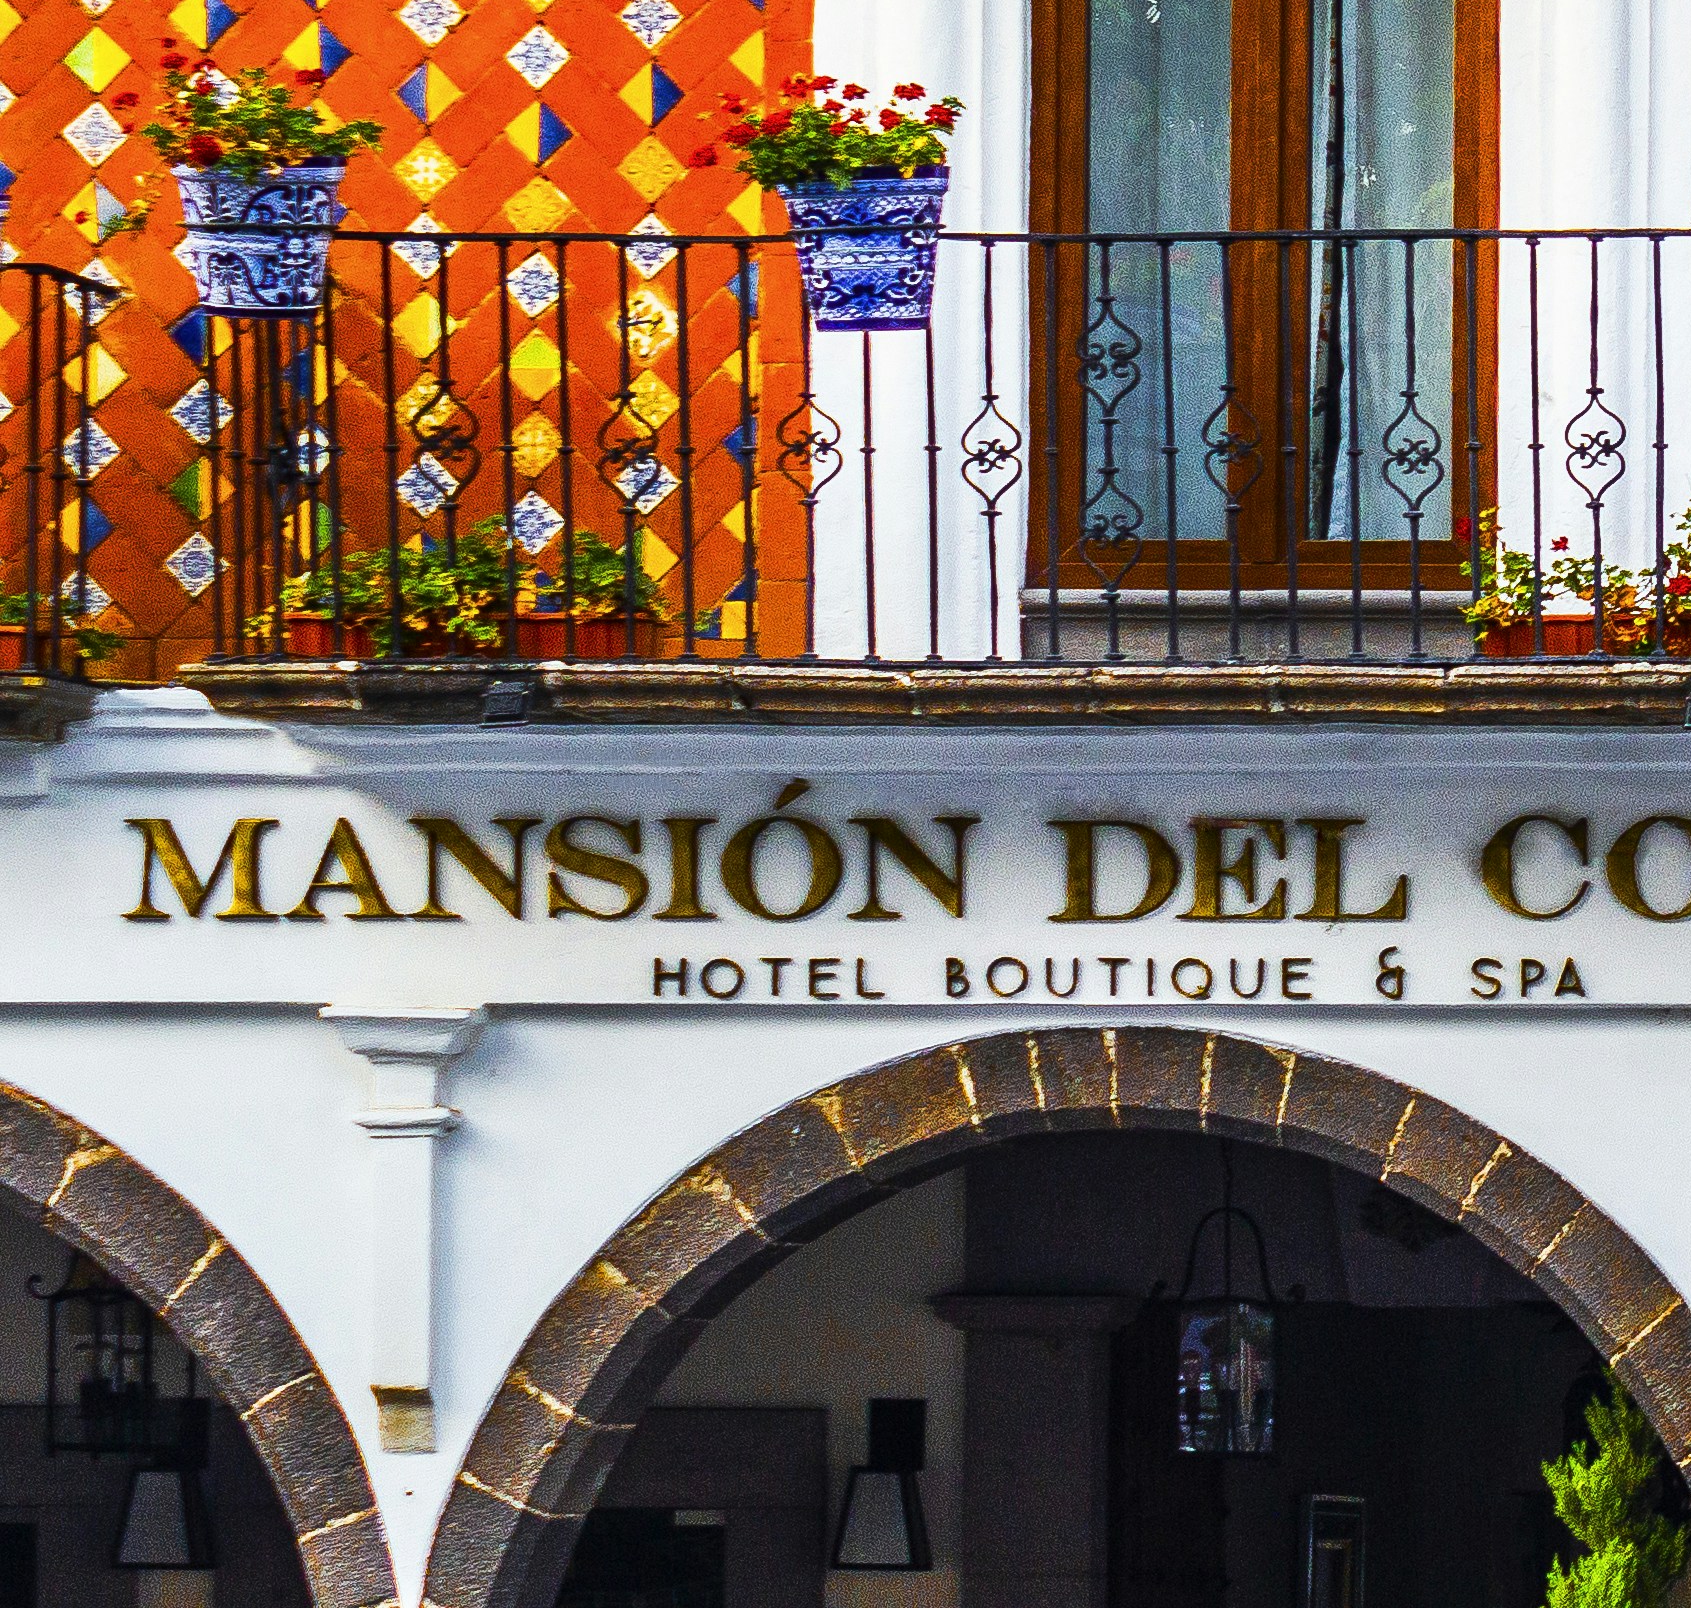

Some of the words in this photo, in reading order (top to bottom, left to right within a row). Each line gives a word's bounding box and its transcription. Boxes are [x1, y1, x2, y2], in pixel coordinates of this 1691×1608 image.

[121, 776, 982, 922] MANSIÓN
[1046, 808, 1409, 923] DEL
[654, 957, 883, 999] HOTEL
[946, 957, 1311, 999] BOUTIQUE
[1376, 947, 1404, 999] &
[1472, 958, 1585, 998] SPA
